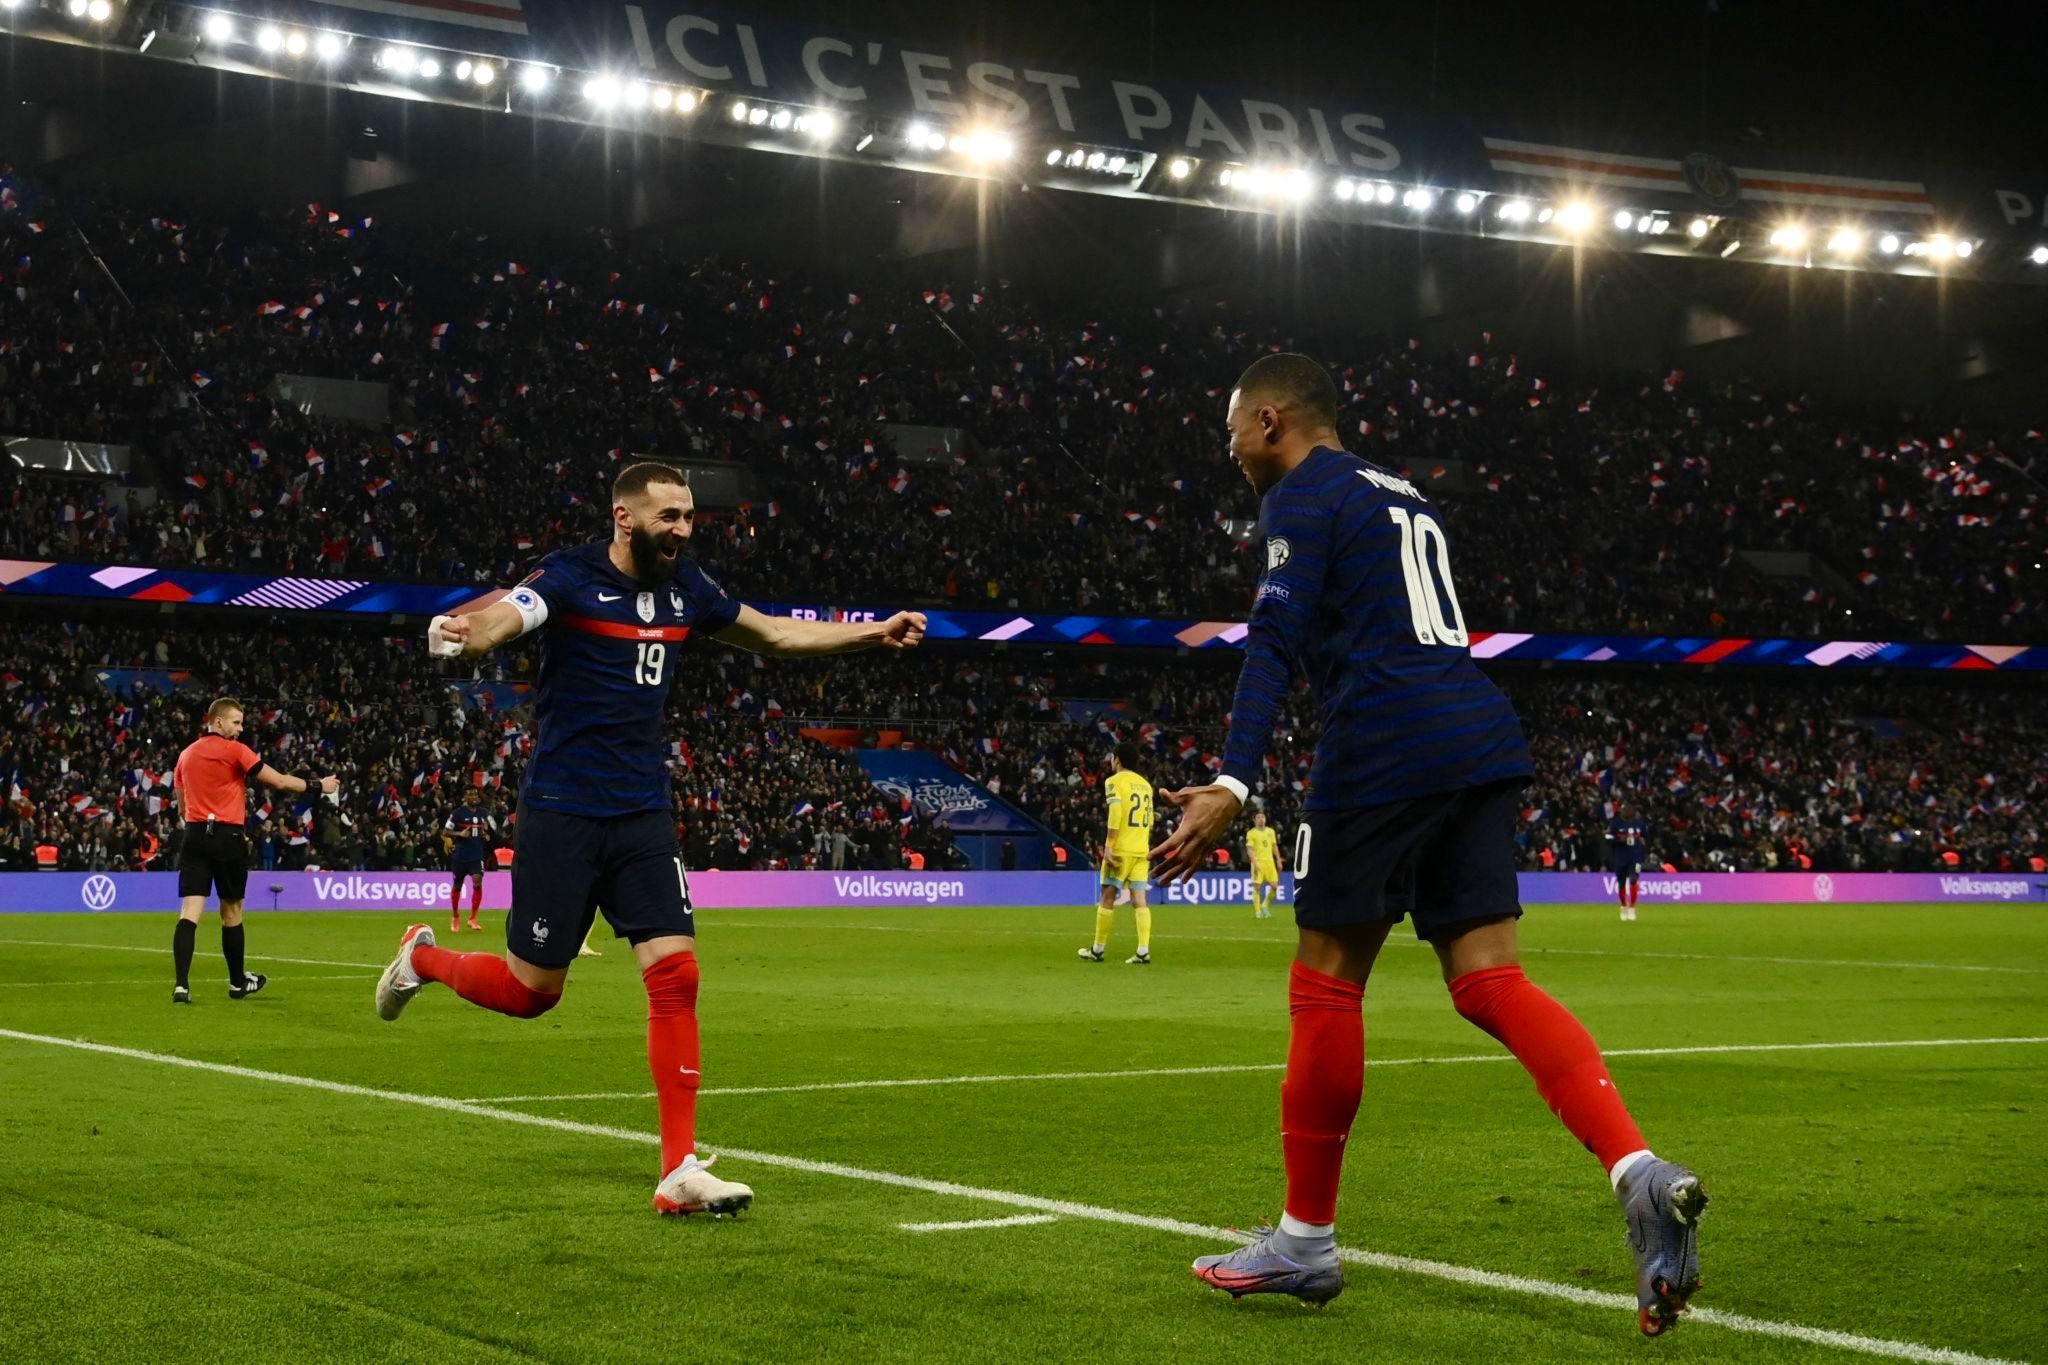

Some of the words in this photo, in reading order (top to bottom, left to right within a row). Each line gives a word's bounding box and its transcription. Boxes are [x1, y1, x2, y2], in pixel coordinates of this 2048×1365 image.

[625, 4, 769, 88] ICI
[802, 37, 1081, 132] C'EST
[1111, 80, 1400, 171] PARIS
[1995, 189, 2048, 227] P
[1387, 507, 1469, 647] 10
[791, 608, 875, 623] FRCE
[635, 642, 665, 686] 19
[1128, 792, 1149, 828] 23
[834, 875, 964, 903] Volkswagen
[1168, 877, 1254, 904] EQUIPE
[1940, 876, 2029, 899] Volkswagen
